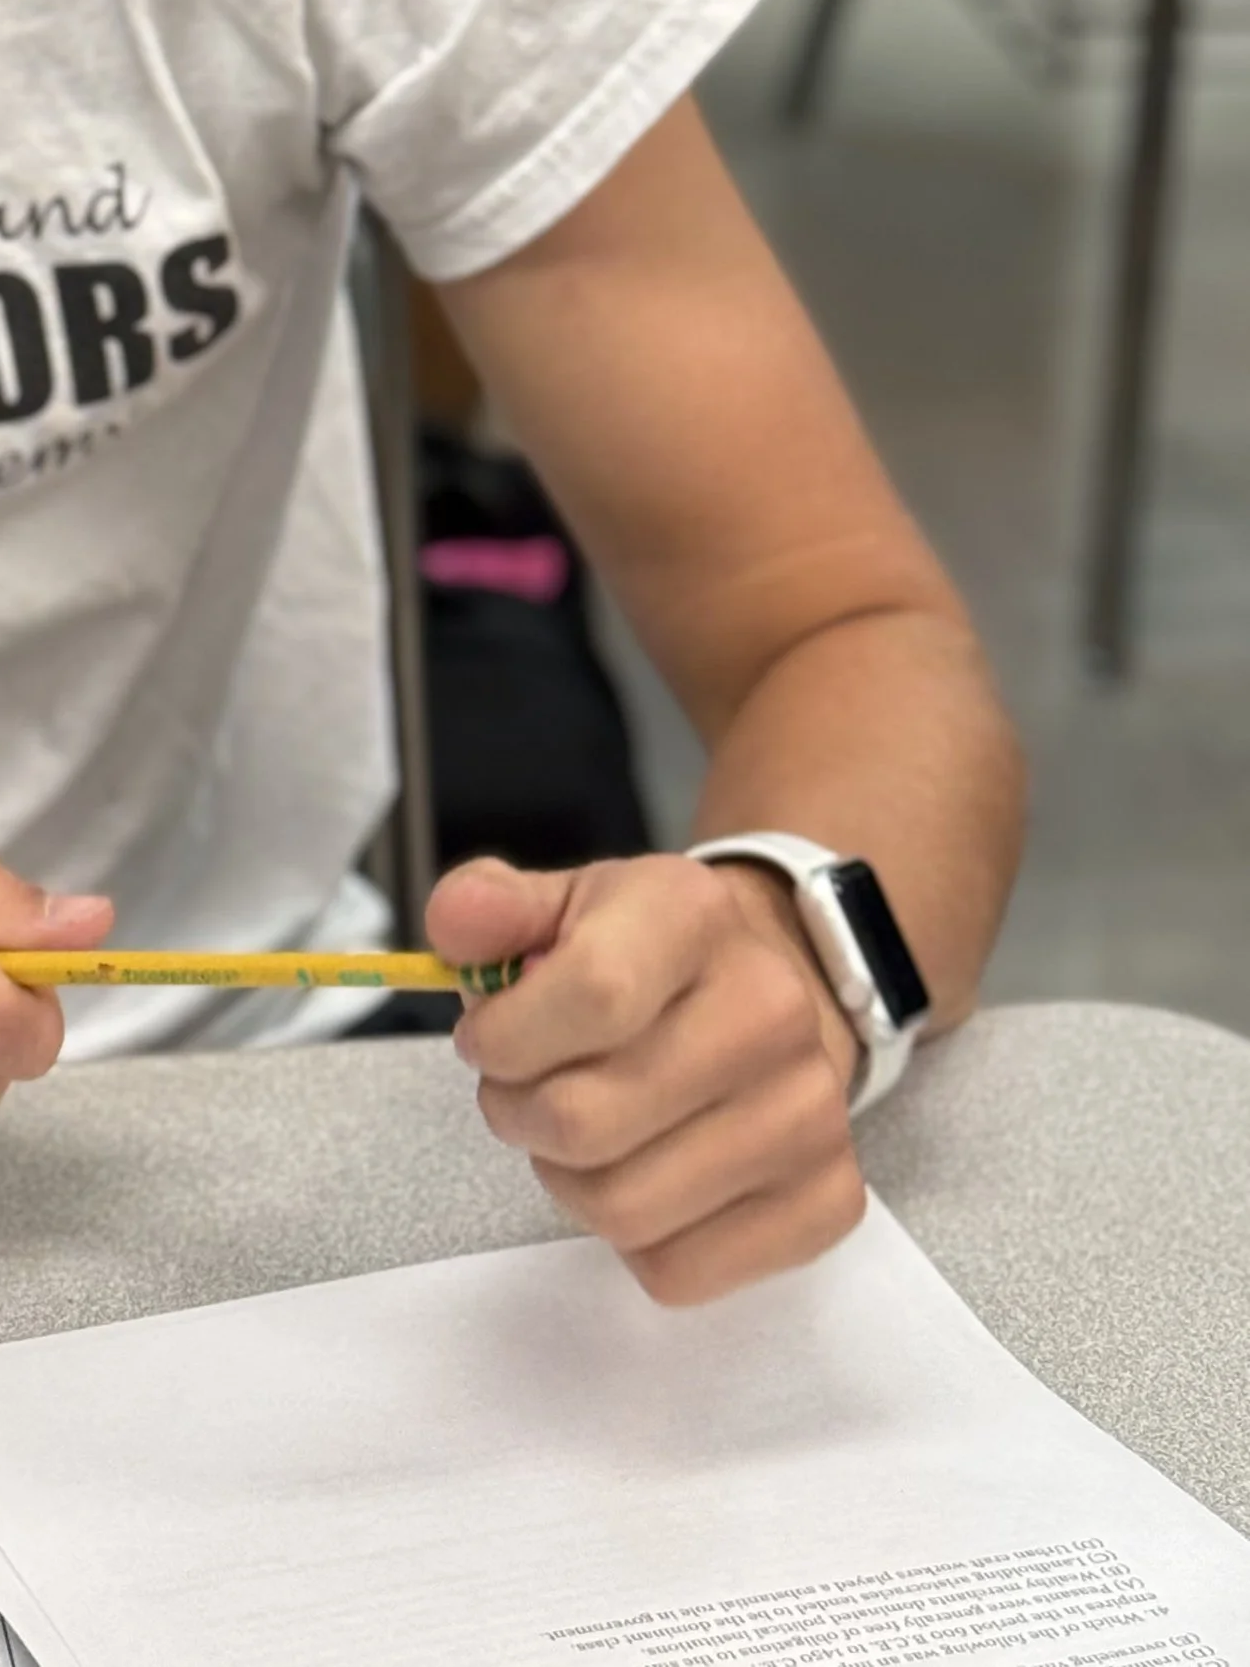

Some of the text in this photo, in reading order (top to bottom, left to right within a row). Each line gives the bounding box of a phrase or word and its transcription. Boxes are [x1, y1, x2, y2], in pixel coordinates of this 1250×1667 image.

[539, 1537, 1105, 1642] (D) Urban craft workers played a substantial role in government.
[1112, 1576, 1146, 1592] (A)
[570, 1549, 1119, 1652] (C) Landholding aristocracies tended to be the dominant class.
[1031, 1582, 1114, 1604] Peasants
[640, 1562, 1131, 1656] (B) Wealthy merchants dominated political institutions.
[987, 1598, 1032, 1612] were
[1062, 1604, 1086, 1616] in
[1084, 1591, 1158, 1615] empires
[903, 1603, 985, 1629] generally
[1029, 1609, 1063, 1622] the
[1143, 1605, 1170, 1618] 41.
[862, 1620, 901, 1634] free
[968, 1612, 1029, 1636] period
[1081, 1612, 1145, 1632] Which
[840, 1627, 862, 1641] of
[929, 1626, 968, 1640] 600
[1027, 1627, 1059, 1641] the
[1060, 1623, 1081, 1638] of
[737, 1631, 839, 1657] obligations
[846, 1643, 869, 1654] to
[868, 1633, 927, 1652] B.C.E.
[938, 1632, 1028, 1656] following
[1067, 1632, 1202, 1667] (E) overseeing
[681, 1654, 715, 1667] the
[715, 1650, 738, 1661] to
[799, 1647, 844, 1664] 1450
[876, 1655, 901, 1667] an
[902, 1649, 941, 1663] was
[1181, 1645, 1216, 1661] (D)
